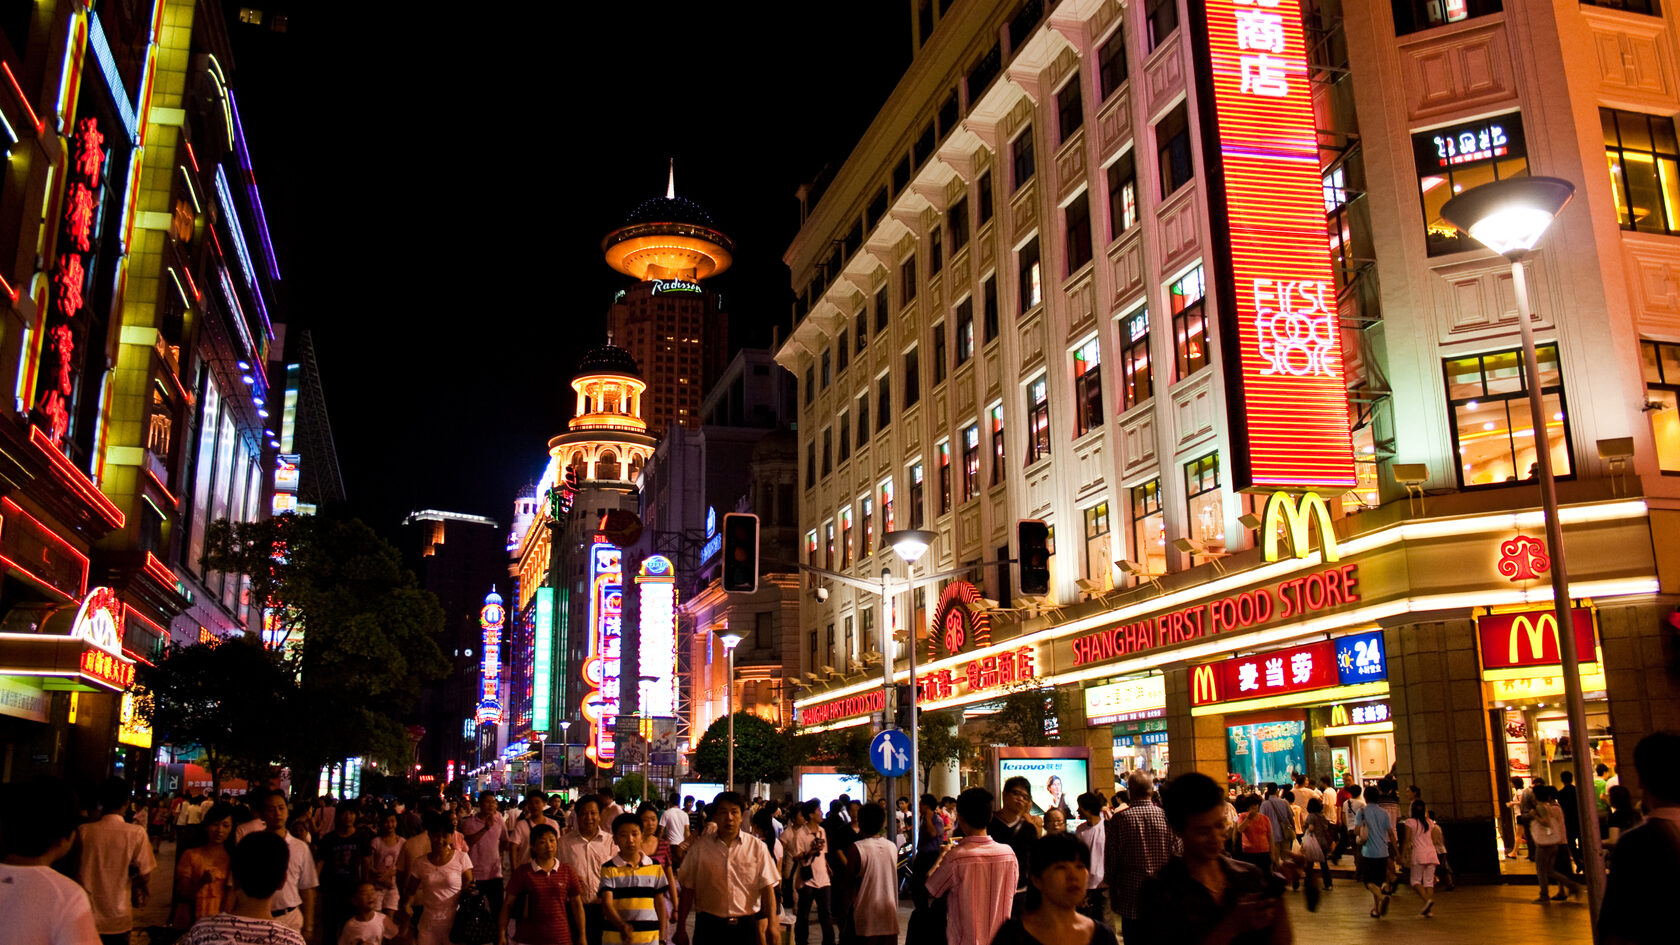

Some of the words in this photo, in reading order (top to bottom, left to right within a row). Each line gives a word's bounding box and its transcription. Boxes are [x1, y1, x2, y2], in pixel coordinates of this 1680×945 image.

[1234, 0, 1288, 97] 商店
[651, 277, 702, 296] Radisson
[1071, 618, 1155, 666] SHANGHAI
[1158, 605, 1206, 647] FIRST
[1211, 589, 1273, 634] FOOD
[1278, 564, 1360, 618] STORE
[1354, 638, 1381, 667] 24
[1238, 652, 1313, 692] 麦当劳
[801, 704, 829, 726] SHANGHAI
[830, 700, 845, 720] FIRST
[846, 694, 865, 716] FOOD
[1351, 703, 1389, 724] 麦当劳
[1003, 762, 1045, 771] lenovo
